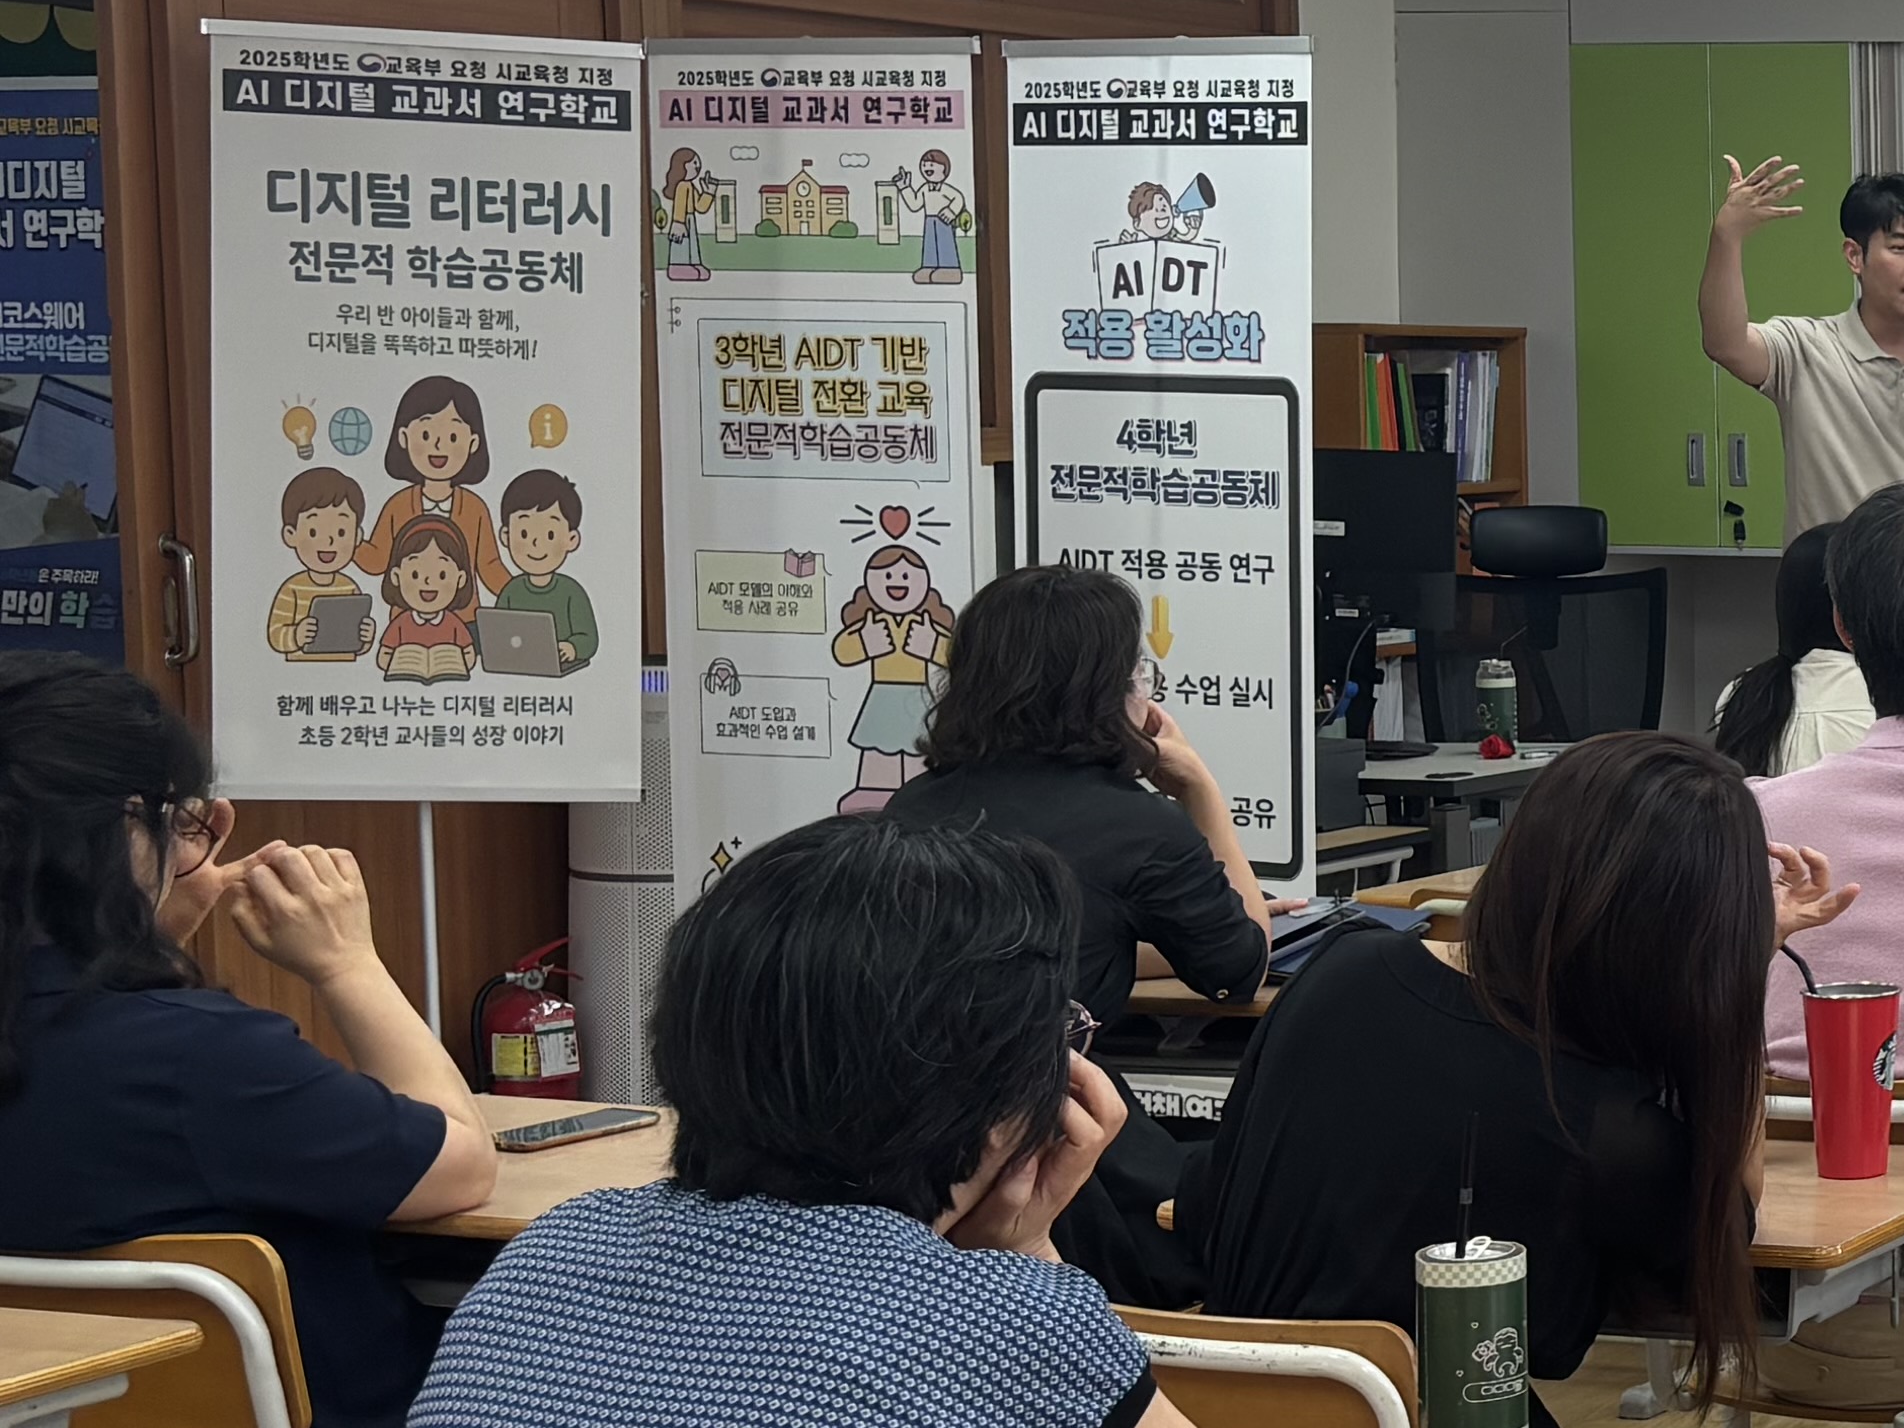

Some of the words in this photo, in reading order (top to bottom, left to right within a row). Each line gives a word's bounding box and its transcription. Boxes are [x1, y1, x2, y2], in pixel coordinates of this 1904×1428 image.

[239, 50, 350, 72] 2025학년도
[386, 56, 442, 76] 교육부
[451, 60, 486, 80] 요청
[496, 62, 570, 84] 시교육청
[578, 66, 613, 86] 지정
[677, 70, 755, 87] 2025학년도
[783, 70, 823, 87] 교육부
[829, 70, 855, 87] 요청
[861, 70, 915, 87] 시교육청
[921, 70, 947, 87] 지정
[236, 79, 269, 106] AI
[284, 81, 376, 113] 디지털
[391, 85, 482, 119] 교과서
[498, 90, 619, 125] 연구학교
[1024, 81, 1101, 99] 2025학년도
[1127, 80, 1166, 98] 교육부
[1172, 80, 1199, 99] 요청
[1206, 80, 1260, 98] 시교육청
[1267, 79, 1294, 98] 지정
[63, 117, 99, 135] 시교육
[668, 97, 692, 121] AI
[704, 96, 770, 123] 디지털
[782, 96, 849, 123] 교과서
[862, 96, 953, 124] 연구학교
[1022, 111, 1046, 139] AI
[1057, 109, 1119, 140] 디지털
[1129, 108, 1196, 139] 교과서
[1207, 107, 1298, 139] 연구학교
[266, 169, 411, 230] 디지털
[430, 176, 612, 237] 리터러시
[23, 207, 104, 248] 연구학
[288, 240, 394, 285] 전문적
[406, 245, 584, 295] 학습공동체
[1112, 260, 1145, 299] AI
[1162, 257, 1208, 296] DT
[0, 302, 85, 329] 코스웨어
[336, 305, 370, 325] 우리
[377, 305, 394, 328] 반
[400, 306, 472, 330] 아이들과
[478, 307, 520, 333] 함께,
[0, 333, 110, 363] 문적학습공
[308, 331, 377, 355] 디지털을
[384, 334, 454, 357] 똑똑하고
[459, 336, 538, 361] 따뜻하게!
[714, 332, 784, 370] 3학년
[794, 334, 864, 371] AIDT
[871, 335, 929, 373] 기반
[1062, 308, 1134, 360] 적용
[1144, 309, 1265, 362] 활성화
[721, 377, 802, 414] 디지털
[812, 378, 870, 416] 전환
[876, 379, 933, 418] 교육
[719, 421, 937, 462] 전문적학습공동체
[1116, 418, 1197, 458] 4학년
[1050, 464, 1280, 509] 전문적학습공동체
[1121, 549, 1168, 579] 적용
[1176, 551, 1222, 582] 공동
[1230, 553, 1275, 584] 연구
[277, 695, 314, 716] 함께
[319, 695, 377, 716] 배우고
[382, 695, 436, 716] 나누는
[443, 695, 496, 717] 디지털
[503, 695, 573, 717] 리터러시
[1175, 674, 1221, 706] 수업
[1229, 676, 1273, 710] 실시
[298, 725, 336, 746] 초등
[341, 725, 389, 747] 2학년
[395, 725, 465, 747] 교사들의
[472, 726, 506, 746] 성장
[513, 726, 564, 746] 이야기
[766, 725, 788, 740] 수업
[1230, 797, 1276, 829] 공유
